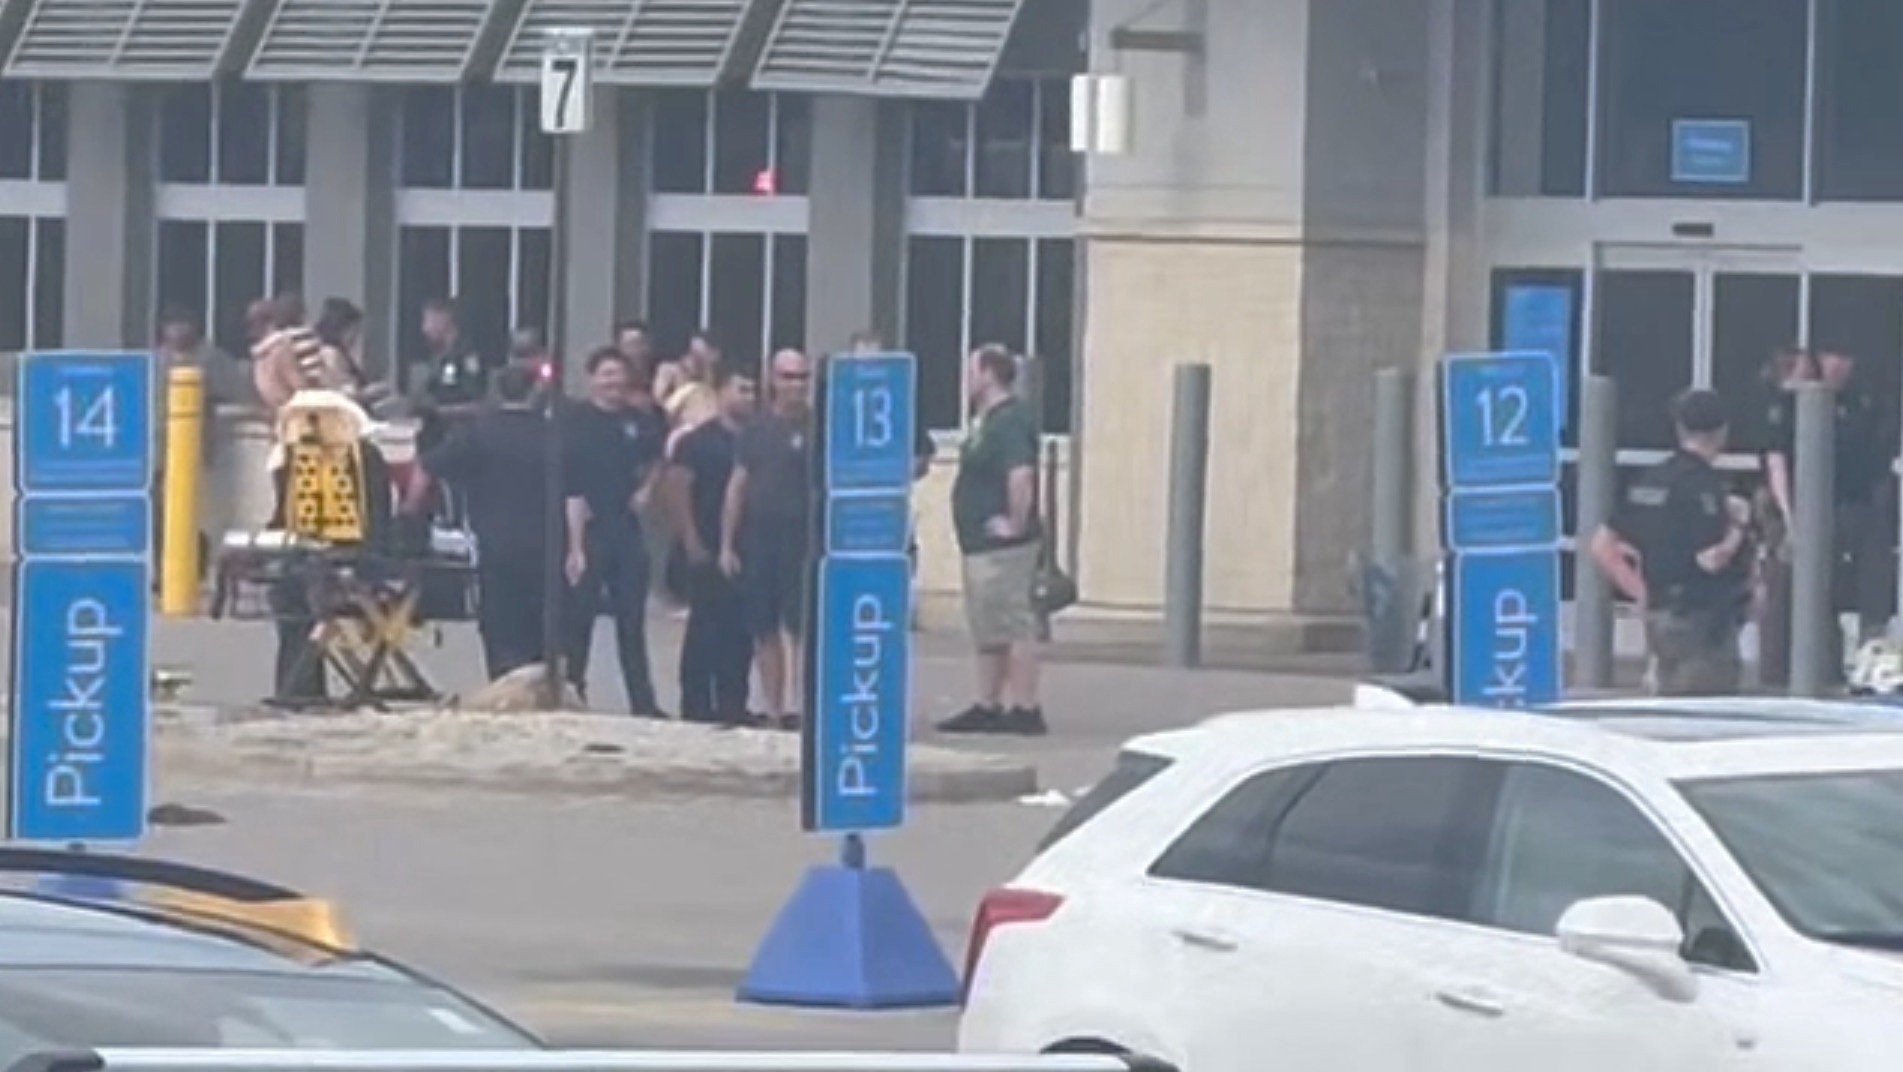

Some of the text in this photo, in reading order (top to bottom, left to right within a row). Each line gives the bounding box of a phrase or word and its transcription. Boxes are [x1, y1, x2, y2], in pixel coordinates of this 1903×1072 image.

[551, 59, 578, 129] 7
[54, 385, 116, 448] 14
[852, 388, 893, 448] 13
[1476, 384, 1530, 447] 12
[45, 598, 123, 808] Pickup
[838, 593, 896, 798] Pickup
